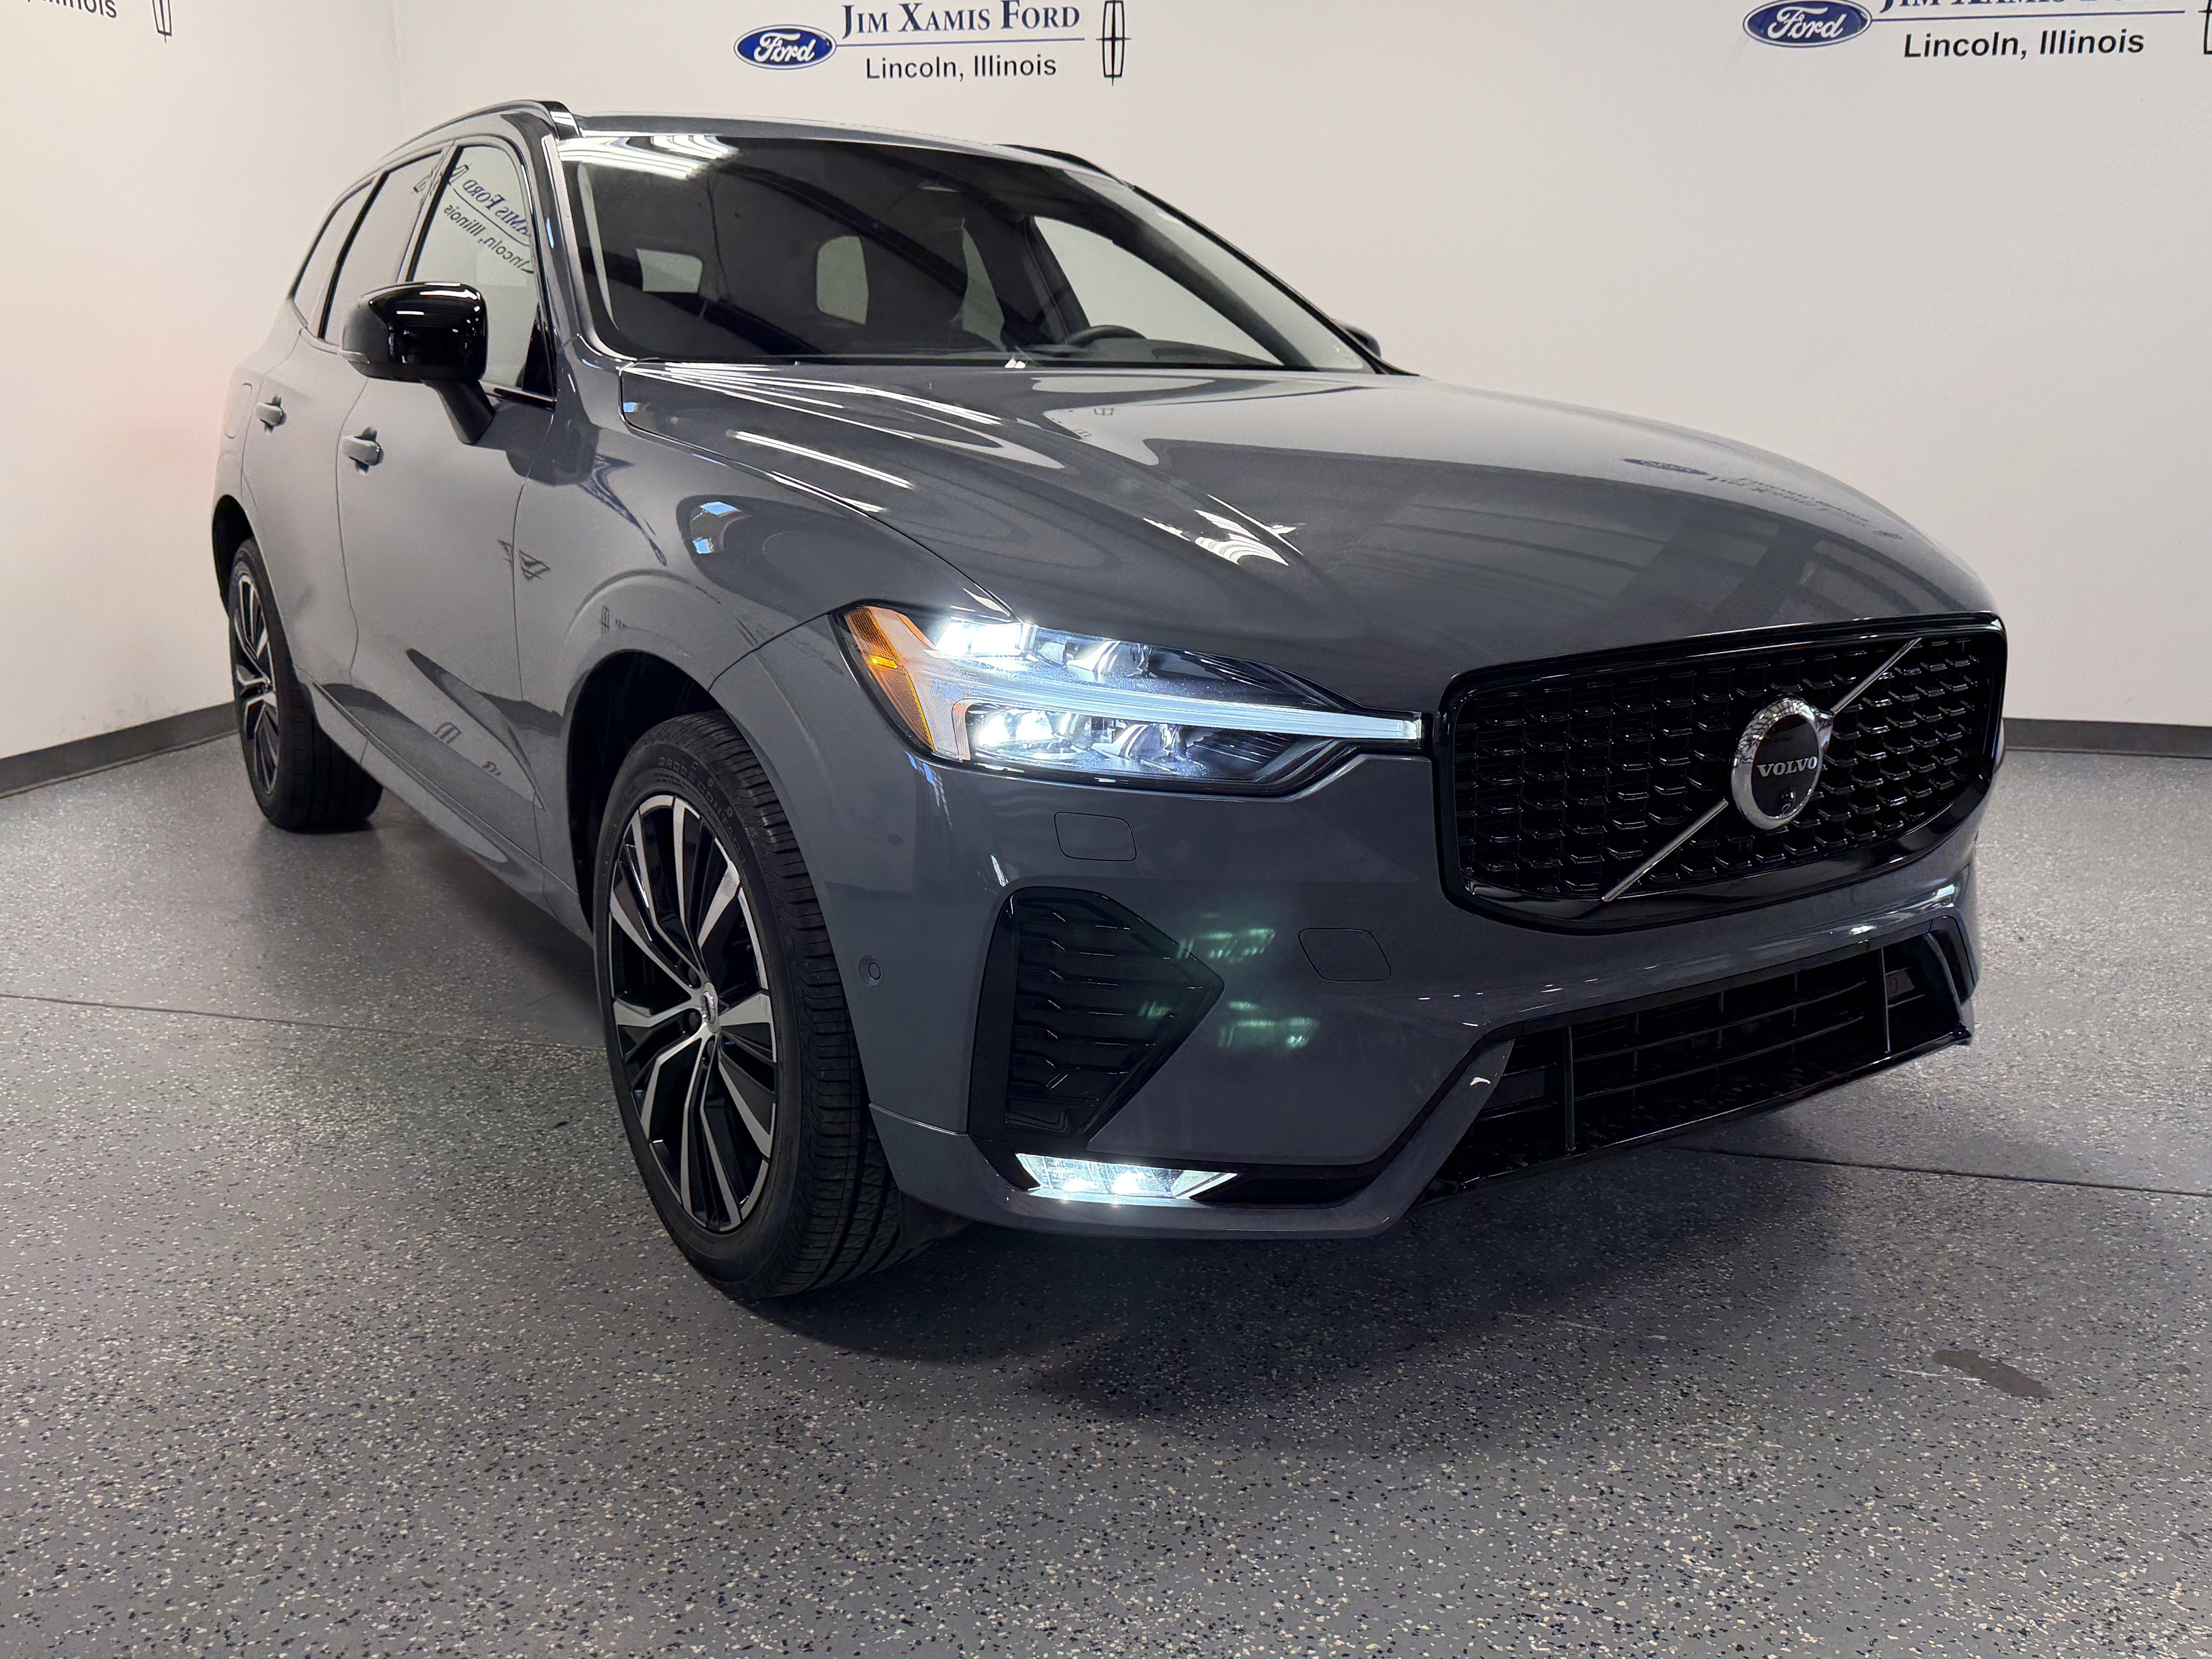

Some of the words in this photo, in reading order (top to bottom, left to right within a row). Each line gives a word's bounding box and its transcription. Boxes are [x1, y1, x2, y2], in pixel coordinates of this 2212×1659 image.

[1767, 6, 1847, 39] Ford
[753, 32, 817, 62] Ford
[1904, 31, 2027, 60] Lincoln,
[2039, 28, 2145, 55] Illinois
[866, 57, 964, 82] Lincoln,
[974, 54, 1057, 77] Illinois
[1756, 756, 1818, 777] VOLVO
